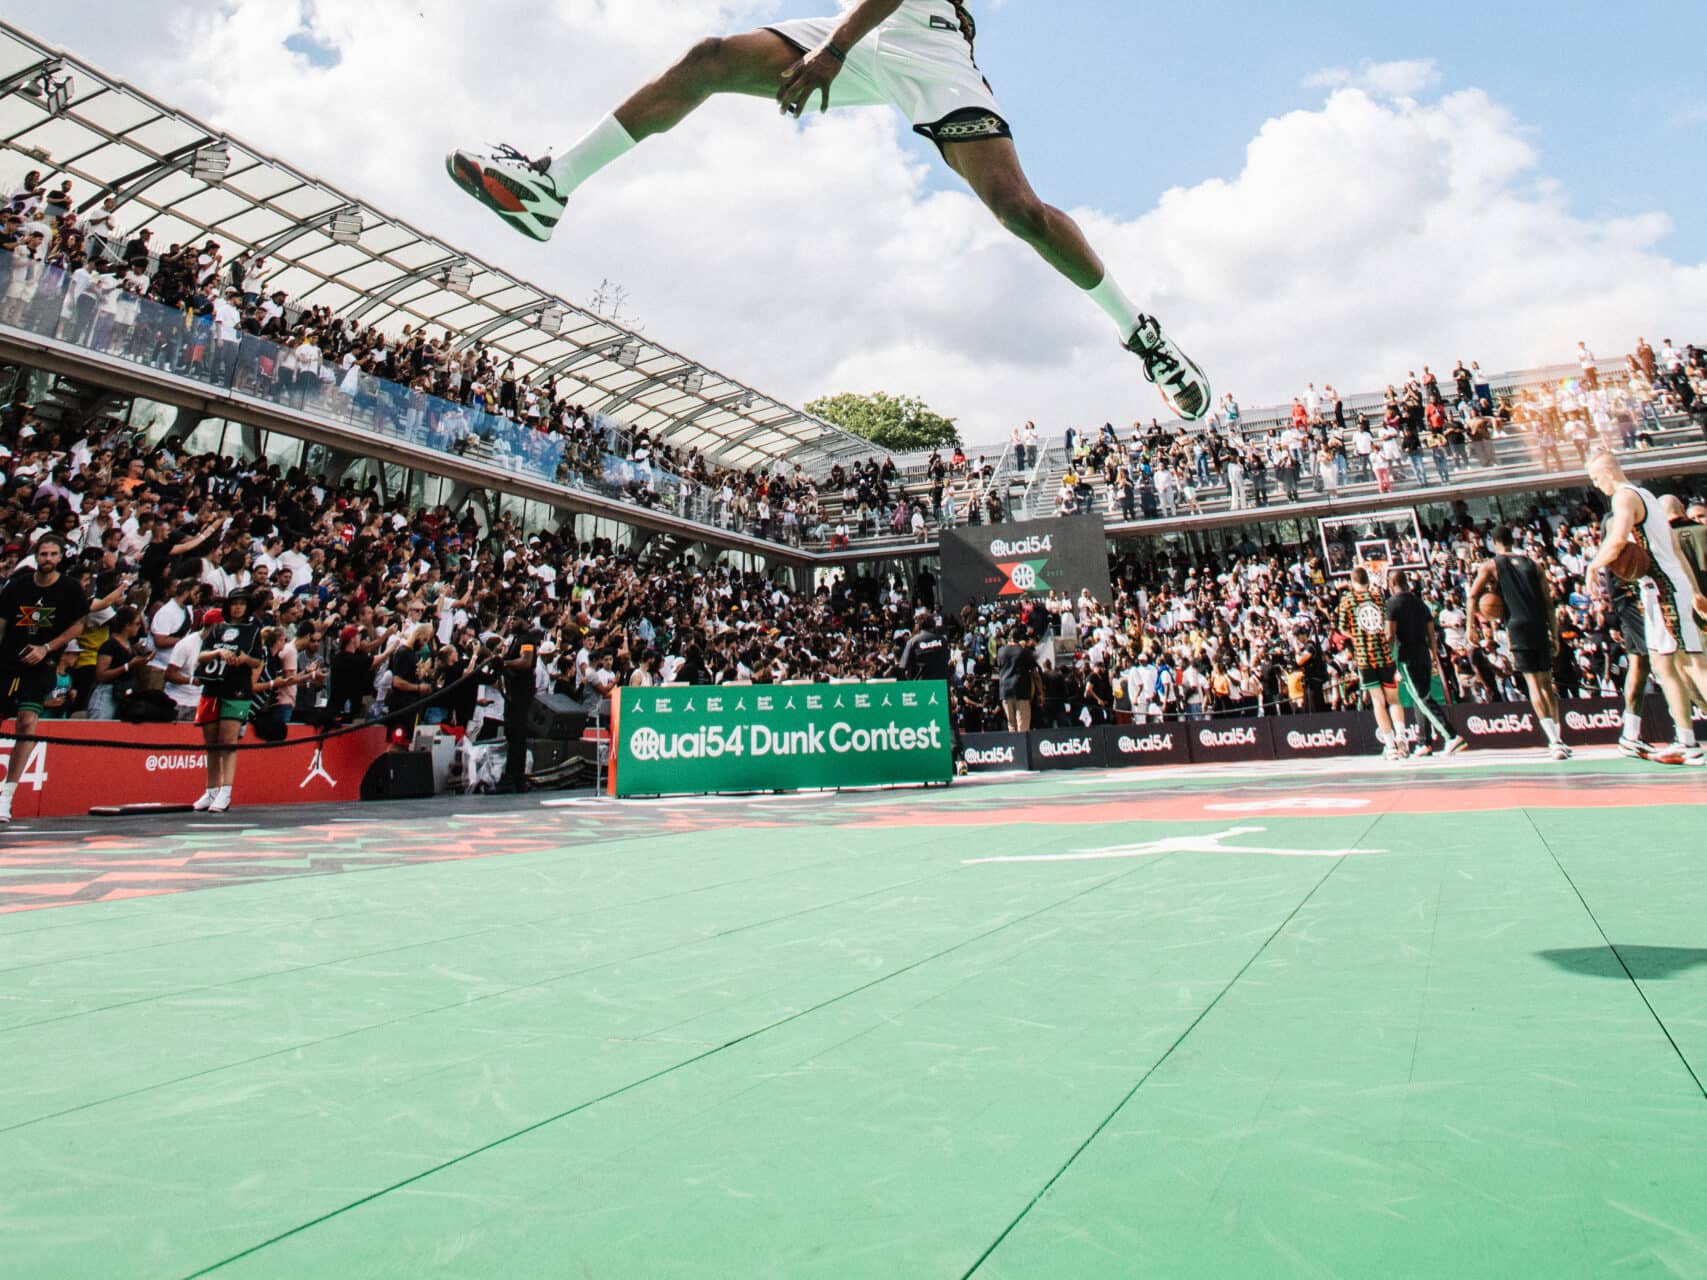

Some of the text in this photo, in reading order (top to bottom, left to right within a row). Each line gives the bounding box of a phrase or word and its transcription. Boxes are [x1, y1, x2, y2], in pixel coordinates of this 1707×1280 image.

[990, 535, 1051, 558] Quai54
[1467, 714, 1532, 735] Quai54
[1565, 709, 1624, 731] Quai5
[630, 719, 942, 760] Quai54 Dunk Contest
[1039, 737, 1091, 756] Quai54
[1118, 734, 1172, 753] Quai54
[1199, 727, 1256, 748] Quai54
[1286, 728, 1346, 749] Quai54
[964, 747, 1013, 764] Quai54
